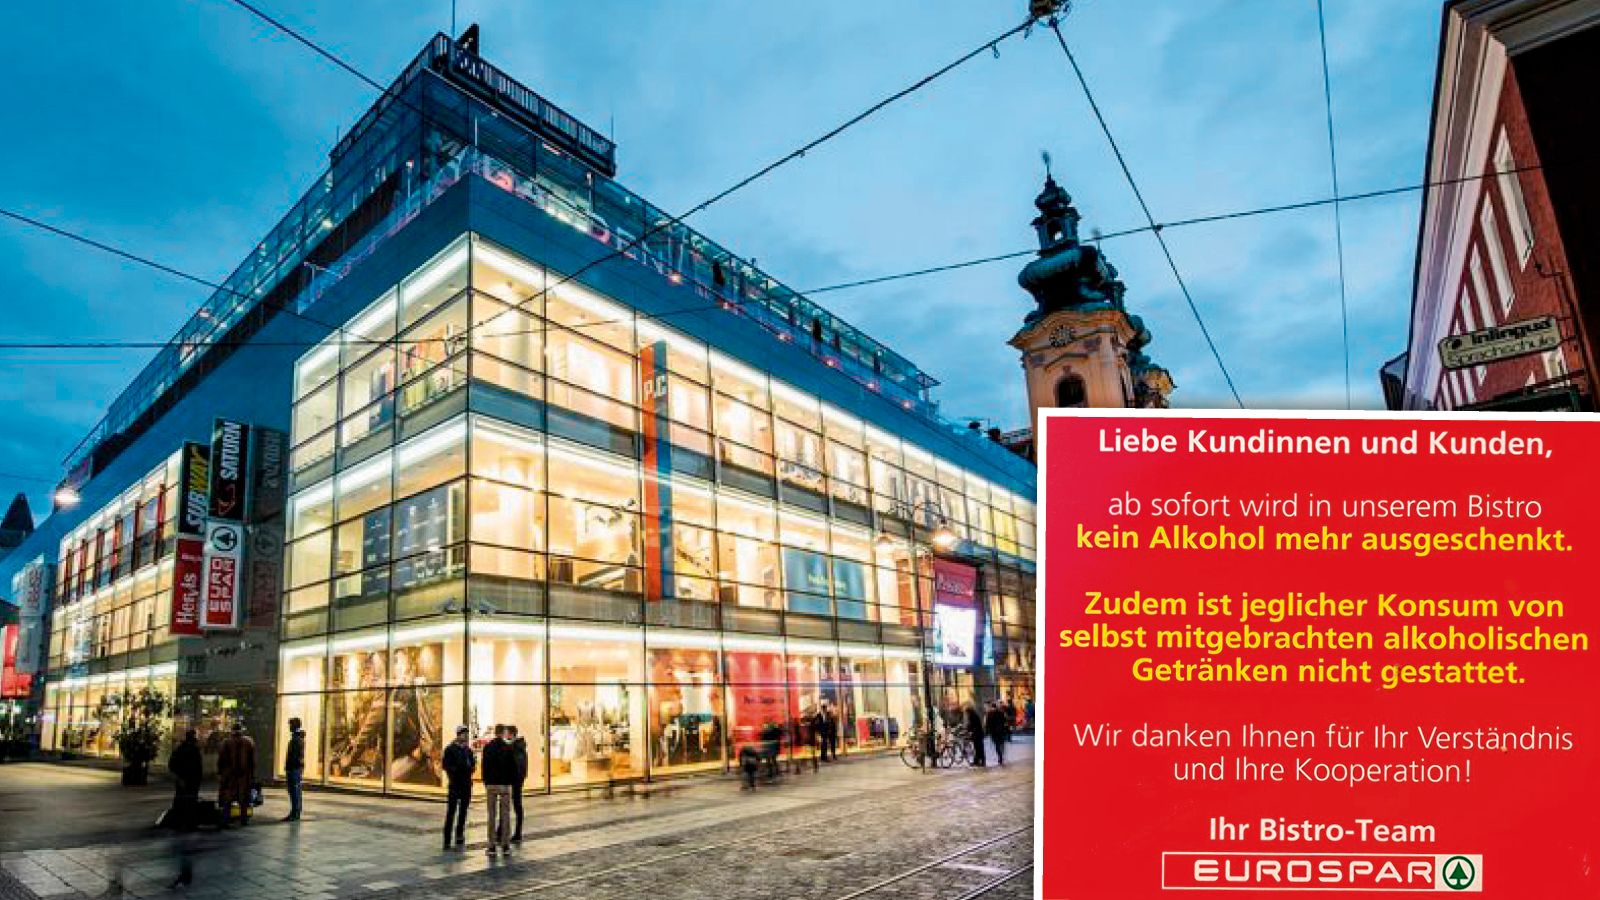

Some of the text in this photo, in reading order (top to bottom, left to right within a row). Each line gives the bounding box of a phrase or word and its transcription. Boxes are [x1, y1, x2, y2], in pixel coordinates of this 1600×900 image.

[220, 421, 242, 481] SATURN
[1099, 427, 1553, 459] Liebe Kundinnen und Kunden,
[186, 445, 209, 533] SUBWAY
[1108, 490, 1542, 519] ab sofort wird in unserem Bistro
[1077, 523, 1573, 557] kein Alkohol mehr ausgeschenkt.
[176, 572, 200, 624] Hervis
[210, 557, 223, 612] EURO
[221, 558, 234, 612] SPAR
[1084, 590, 1564, 623] Zudem ist jeglicher Konsum von
[1059, 622, 1589, 655] selbst mitgebrachten alkoholischen
[1132, 656, 1525, 690] Getränken nicht gestattet.
[1073, 722, 1573, 751] Wir danken Ihnen für Ihr Verständnis
[1174, 755, 1472, 787] und Ihre Kooperation!
[1210, 815, 1436, 843] Ihr Bistro-Team
[1193, 859, 1433, 884] EUROSPAR
